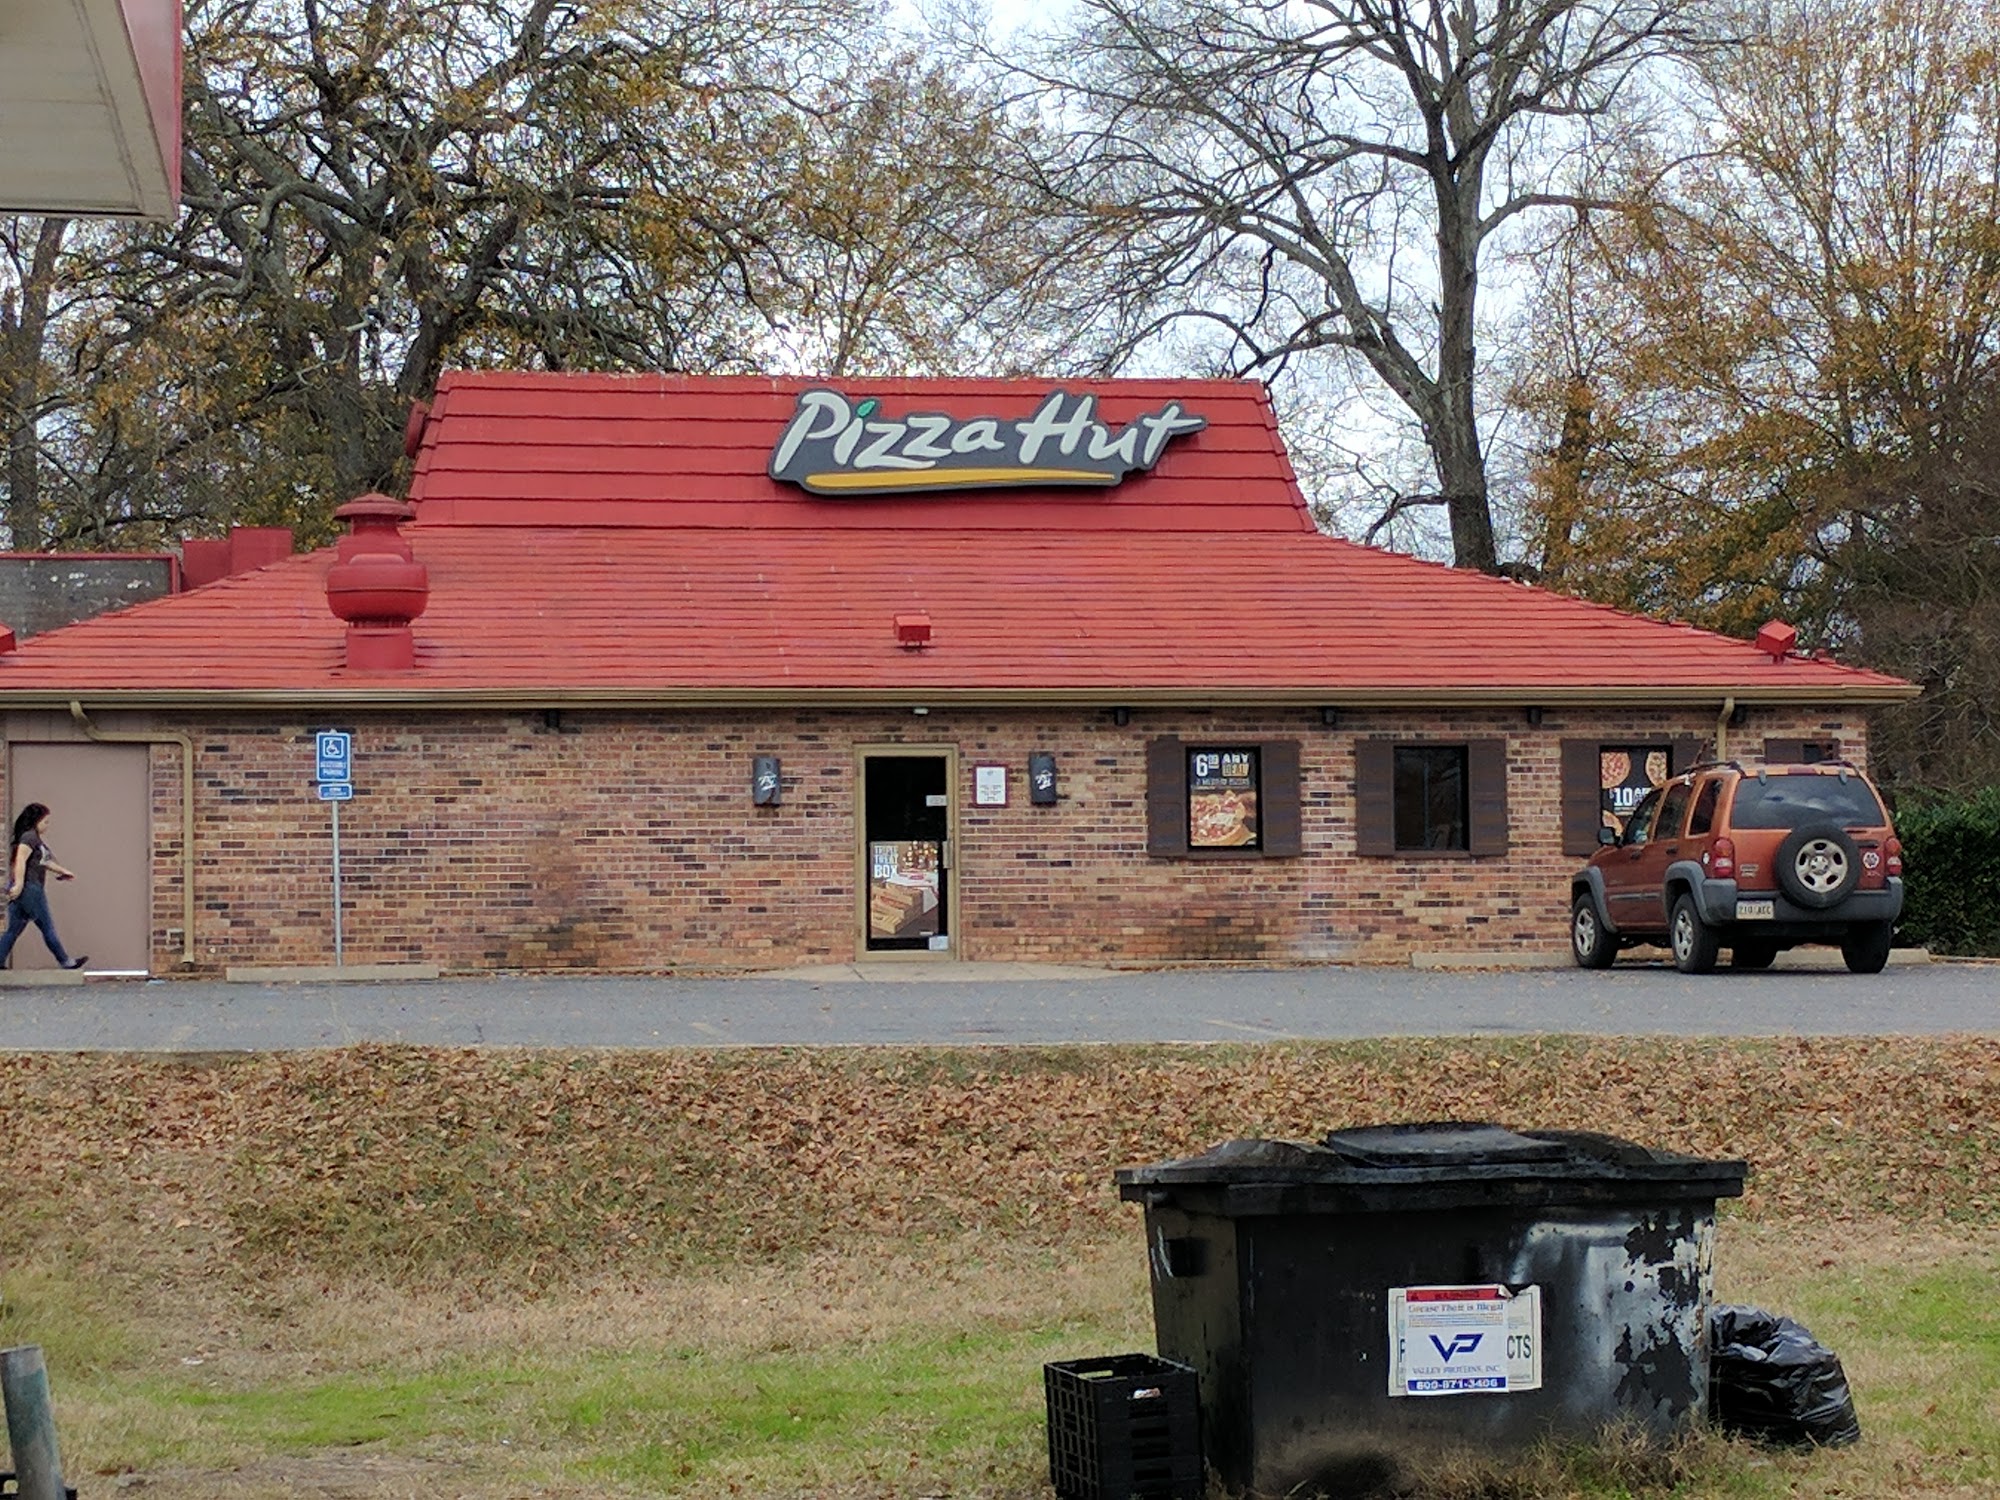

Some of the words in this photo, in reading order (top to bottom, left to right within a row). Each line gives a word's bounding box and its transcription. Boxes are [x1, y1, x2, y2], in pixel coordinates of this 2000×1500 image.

[774, 391, 1005, 473] Pizza
[1016, 392, 1204, 465] Hut
[874, 864, 898, 878] BOX
[1408, 1303, 1439, 1313] Grease
[1441, 1302, 1464, 1312] Theft
[1466, 1303, 1474, 1311] is
[1476, 1301, 1504, 1312] Illegal
[1412, 1366, 1440, 1375] VALLEY
